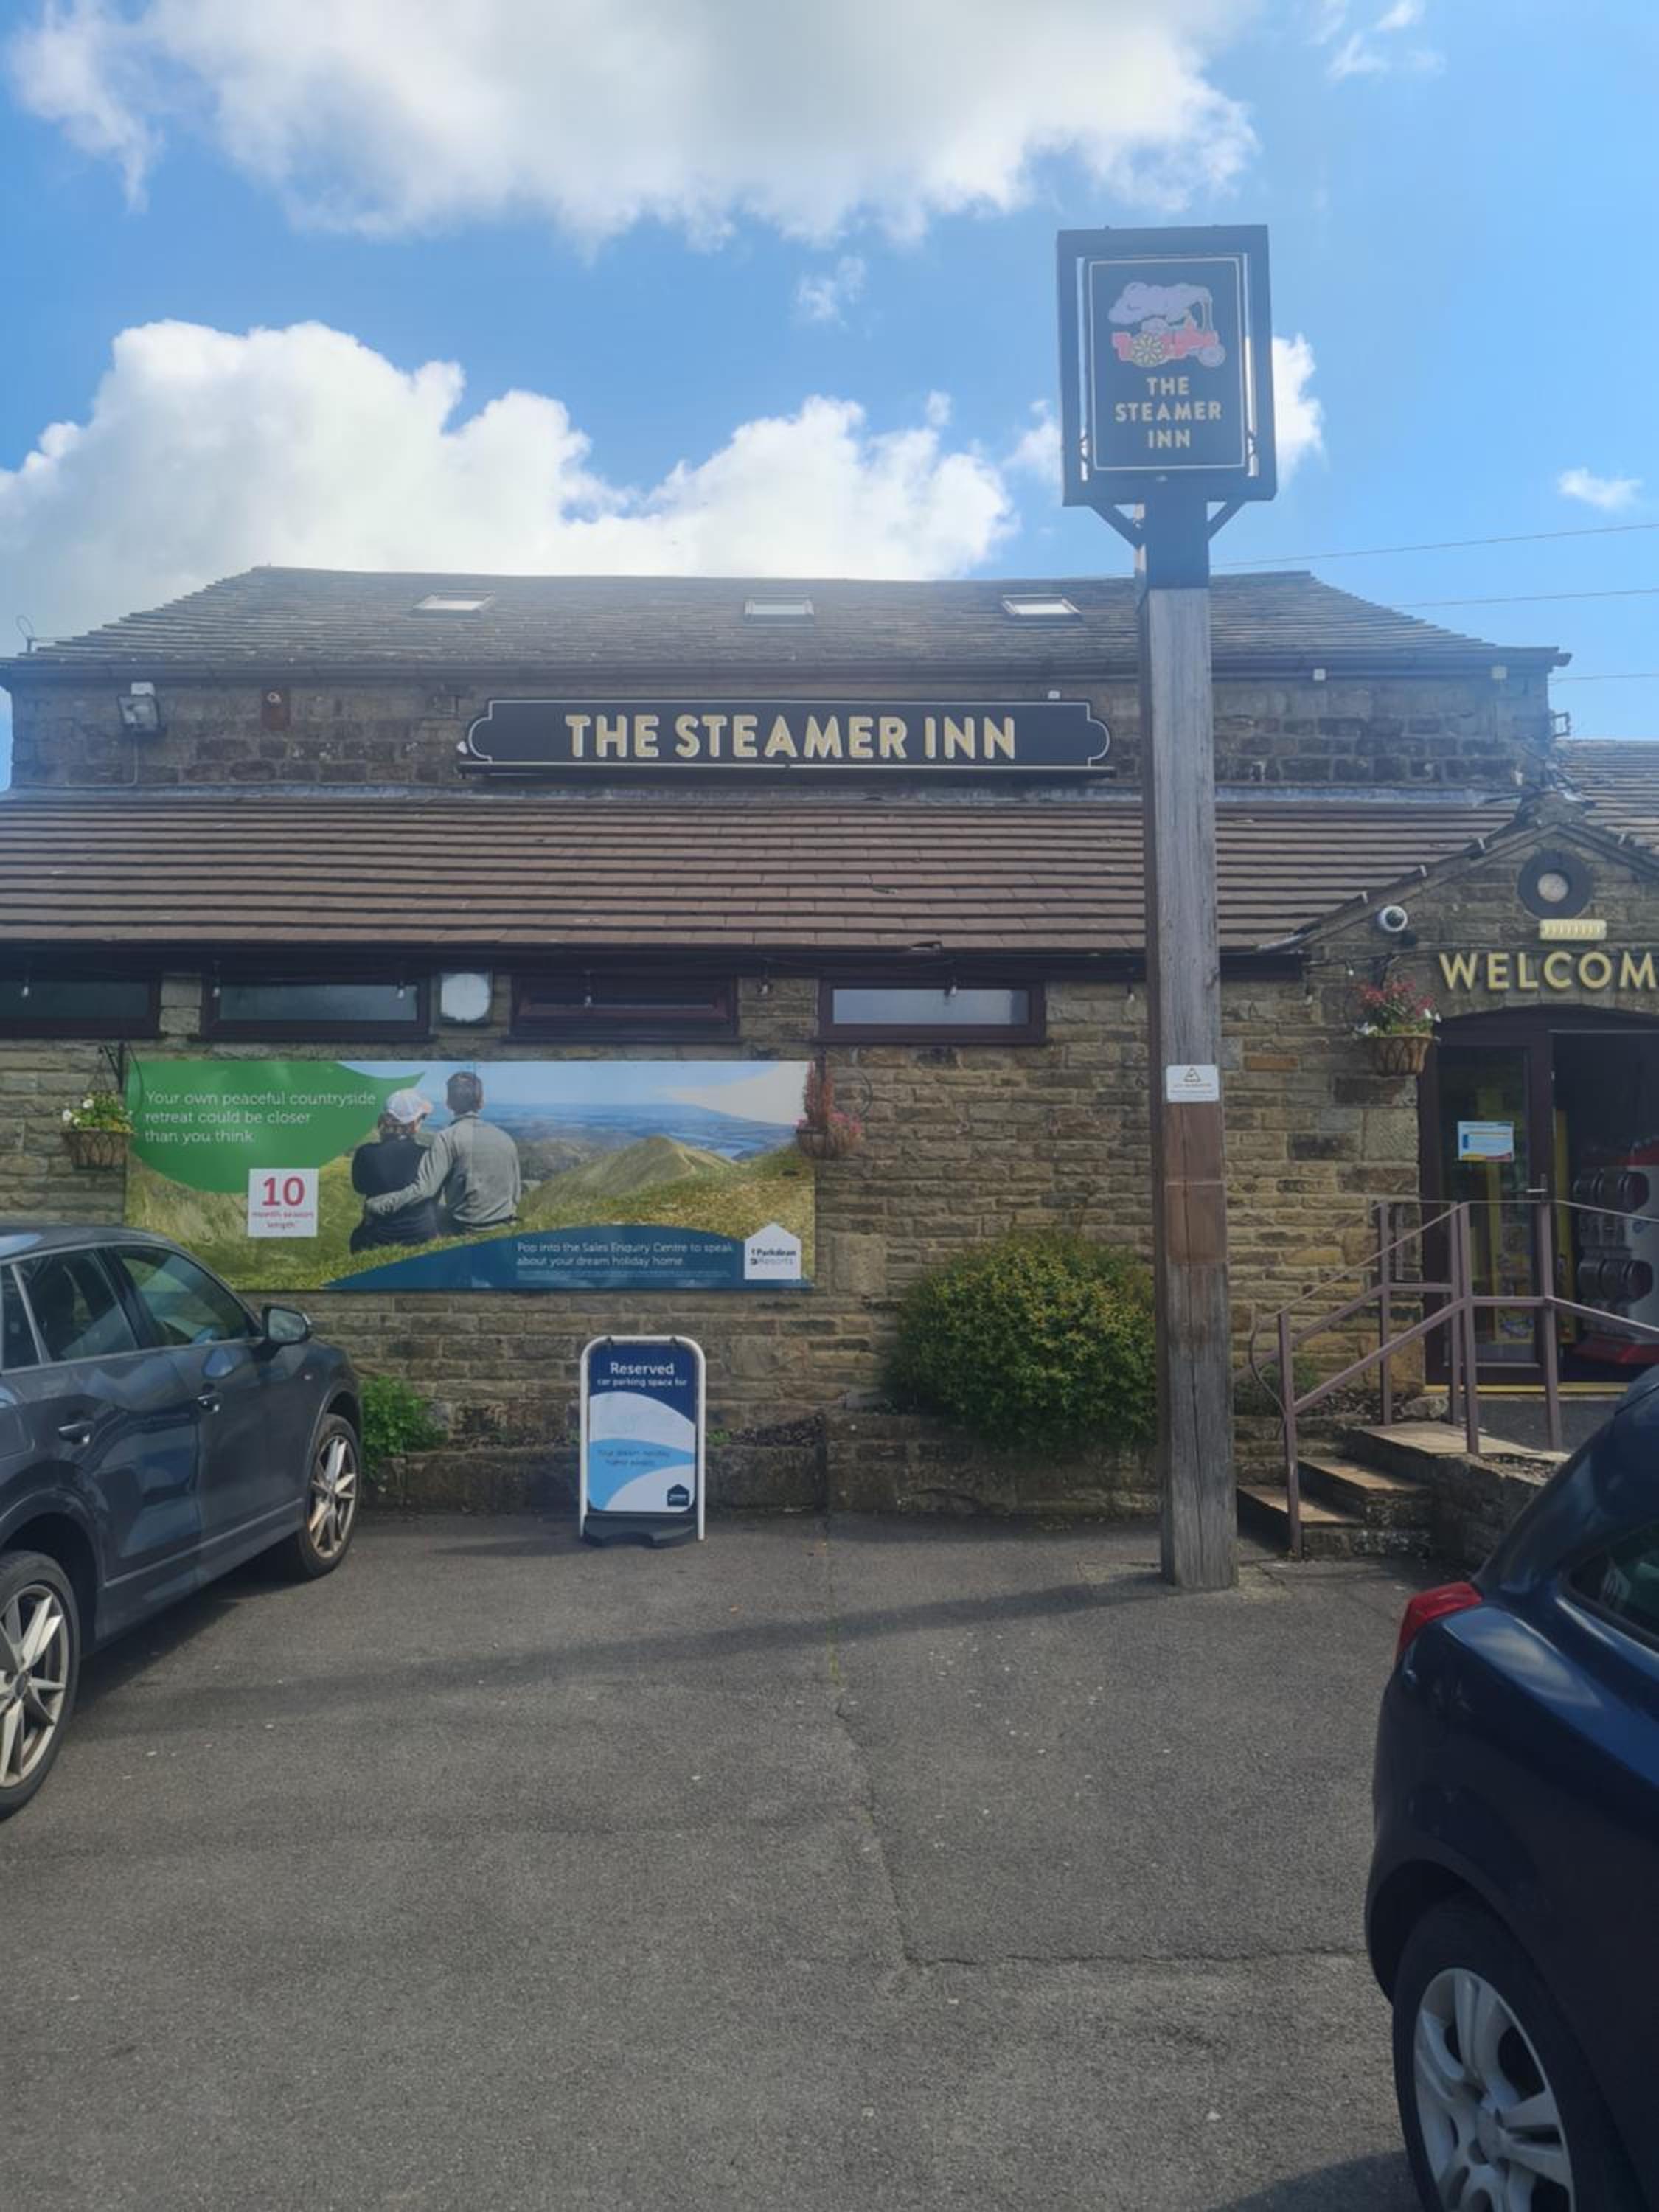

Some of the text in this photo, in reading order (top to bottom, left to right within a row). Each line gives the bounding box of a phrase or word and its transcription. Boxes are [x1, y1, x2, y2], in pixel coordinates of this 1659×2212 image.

[1146, 377, 1189, 396] THE
[1115, 402, 1222, 422] STEAMER
[1147, 429, 1191, 448] INN
[565, 714, 1015, 760] THE STEAMER INN
[147, 1091, 377, 1107] Your own peaceful countryside
[145, 1111, 310, 1124] retreat could be closer
[145, 1130, 178, 1143] than
[181, 1133, 212, 1146] you
[262, 1177, 305, 1206] 10
[518, 1242, 733, 1255] Pop into the Sales Enquiry Centre to speak
[517, 1256, 547, 1266] about
[550, 1258, 573, 1268] your
[576, 1256, 610, 1266] dream
[612, 1256, 650, 1268] holiday
[610, 1362, 675, 1375] Reserved
[613, 1377, 647, 1387] parking
[648, 1379, 672, 1387] space
[675, 1377, 687, 1385] for
